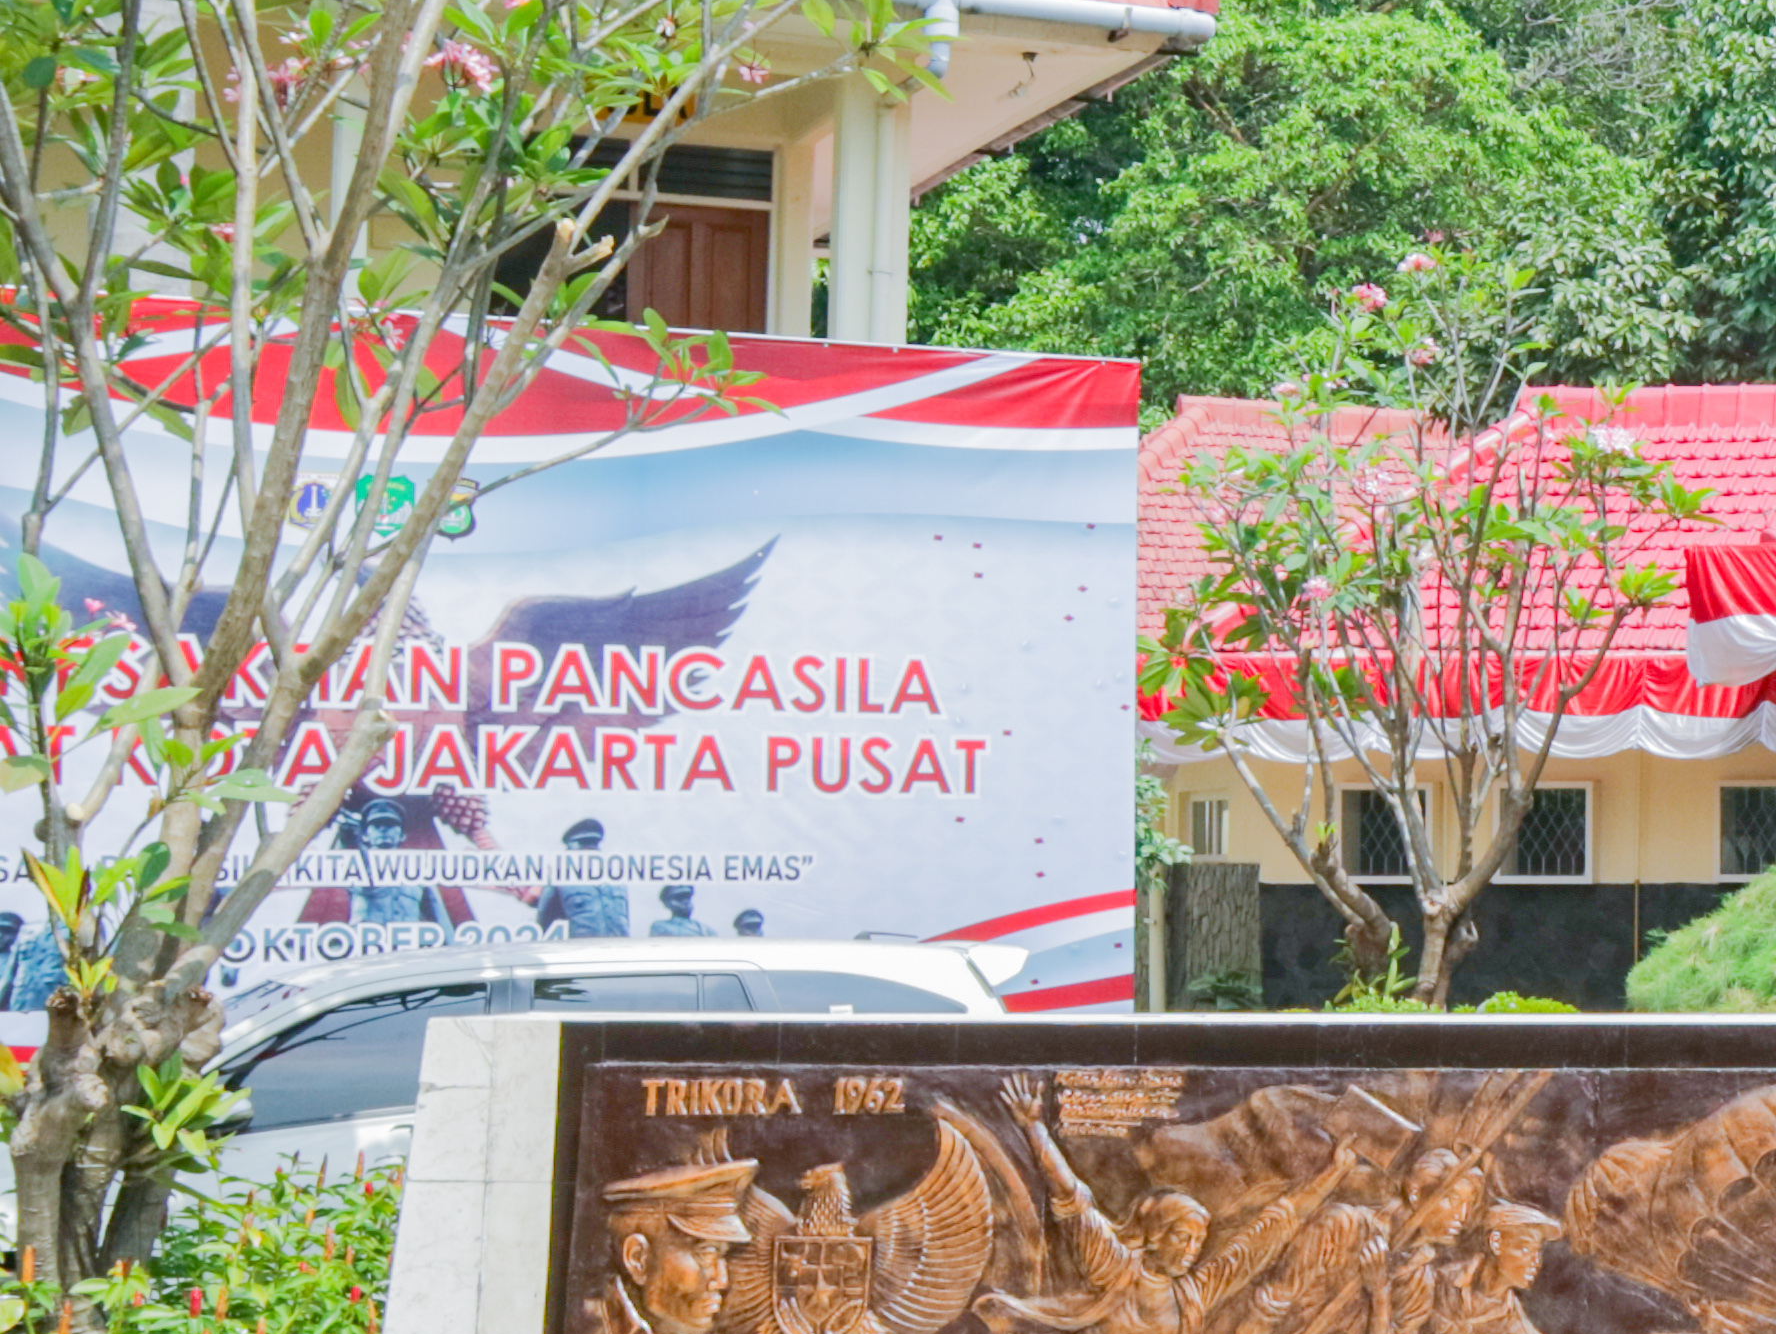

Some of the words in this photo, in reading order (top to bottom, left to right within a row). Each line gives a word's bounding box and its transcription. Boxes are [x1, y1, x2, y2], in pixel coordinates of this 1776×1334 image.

[498, 647, 941, 715] PANCASILA
[373, 728, 736, 793] JAKARTA
[766, 734, 987, 795] PUSAT
[294, 854, 362, 883] KITA
[373, 853, 543, 883] WUJUDKAN
[555, 852, 713, 883] INDONESIA
[222, 926, 443, 963] OKTOBER
[641, 1076, 802, 1117] TRIKORA
[833, 1075, 908, 1115] 1962
